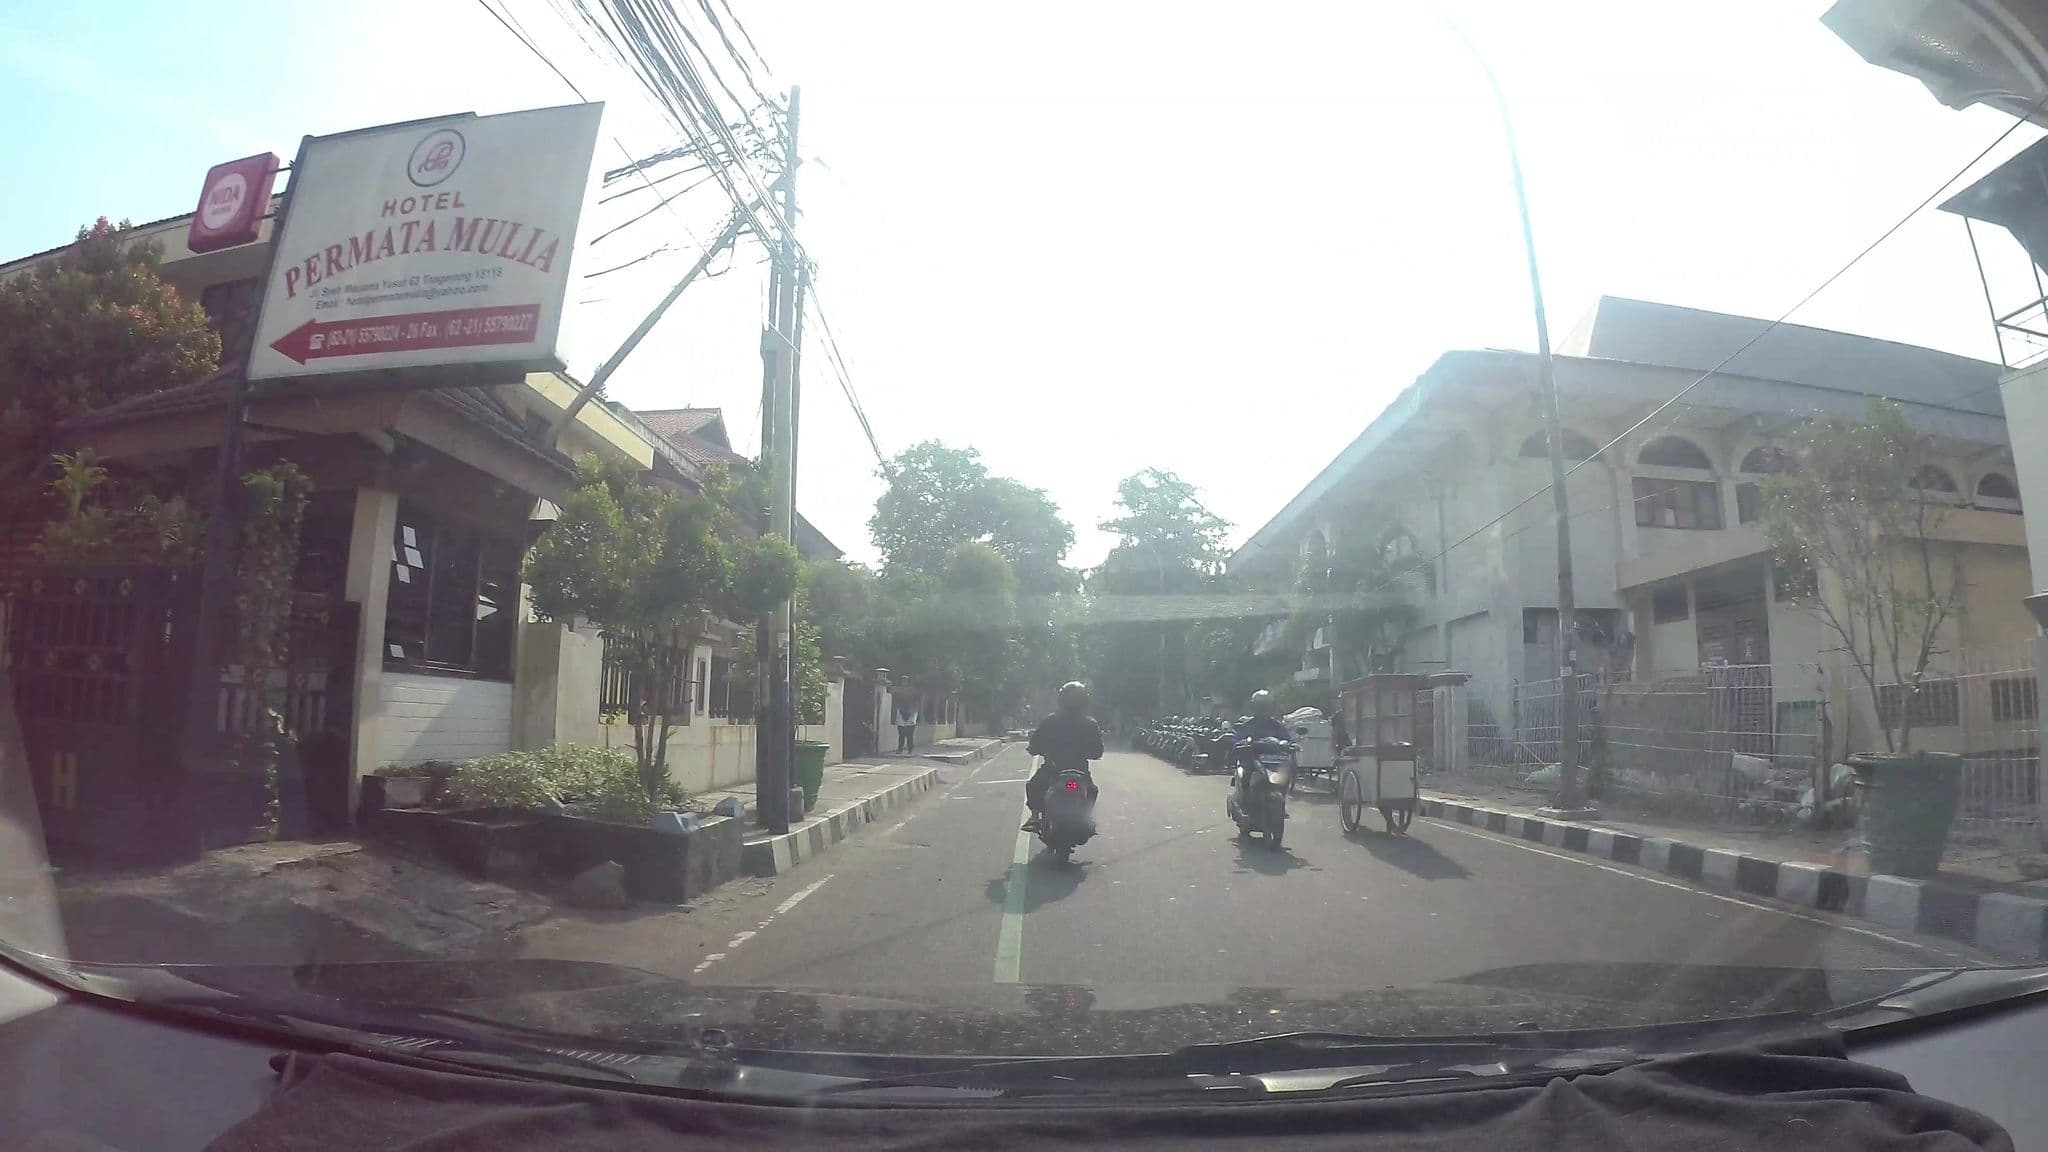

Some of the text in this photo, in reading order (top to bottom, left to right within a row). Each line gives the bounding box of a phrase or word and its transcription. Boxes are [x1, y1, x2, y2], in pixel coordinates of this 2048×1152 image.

[381, 191, 465, 218] HOTEL
[284, 216, 560, 300] PERMATA MULIA
